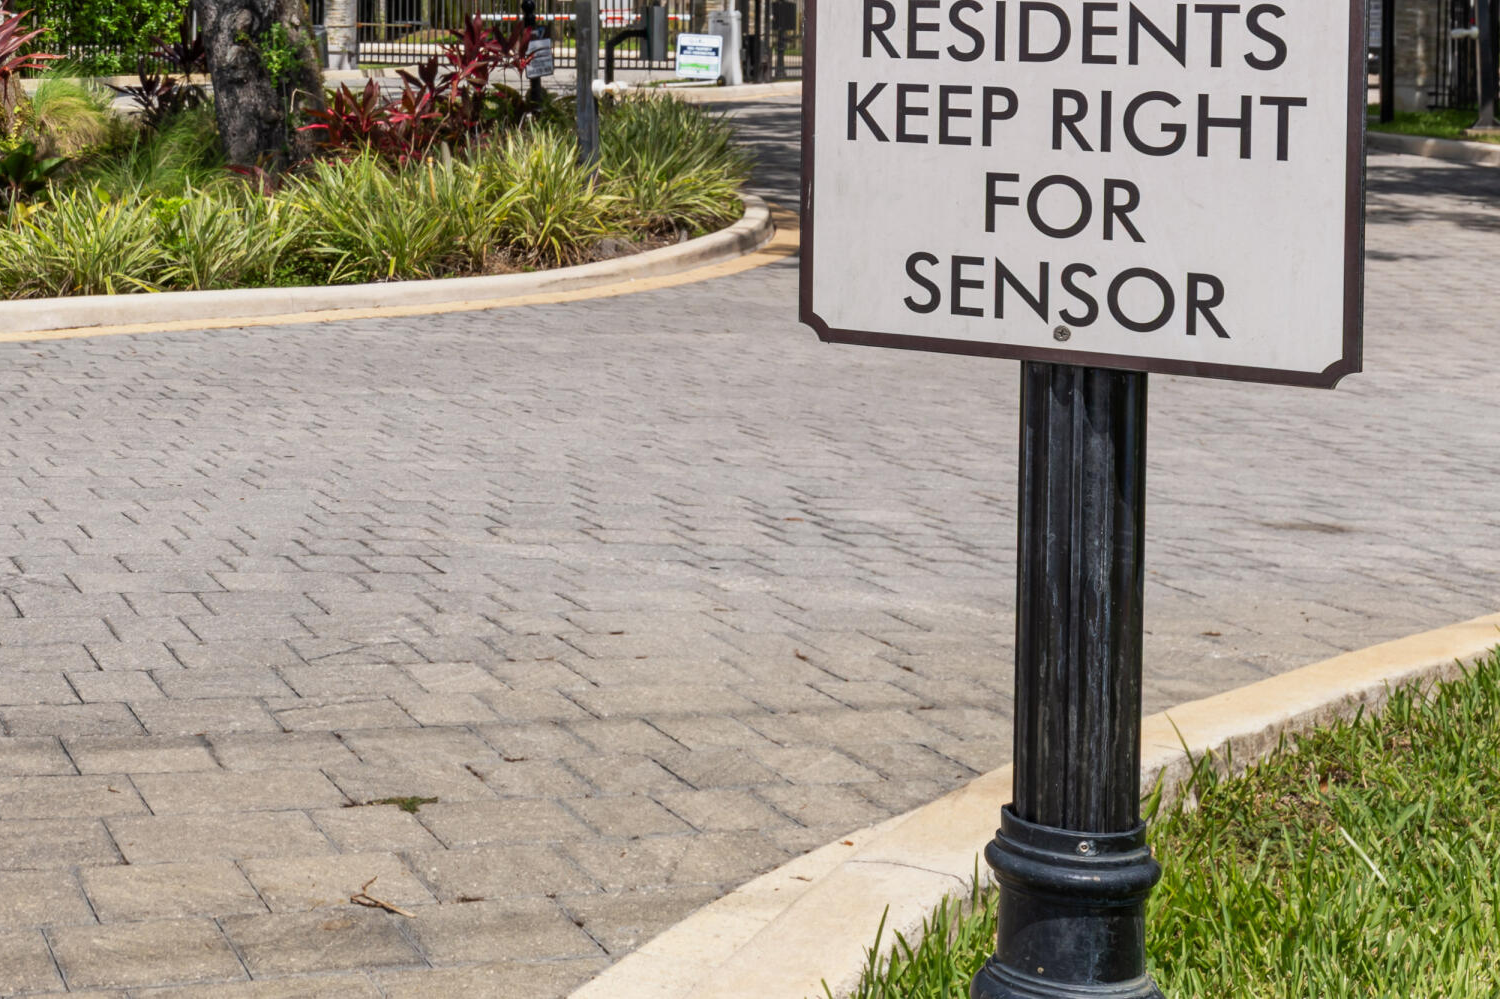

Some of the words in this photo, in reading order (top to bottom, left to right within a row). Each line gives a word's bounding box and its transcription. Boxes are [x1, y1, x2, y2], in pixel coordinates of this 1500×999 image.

[846, 81, 1019, 147] KEEP
[1051, 88, 1308, 162] RIGHT
[984, 172, 1146, 243] FOR
[903, 251, 1231, 339] SENSOR
